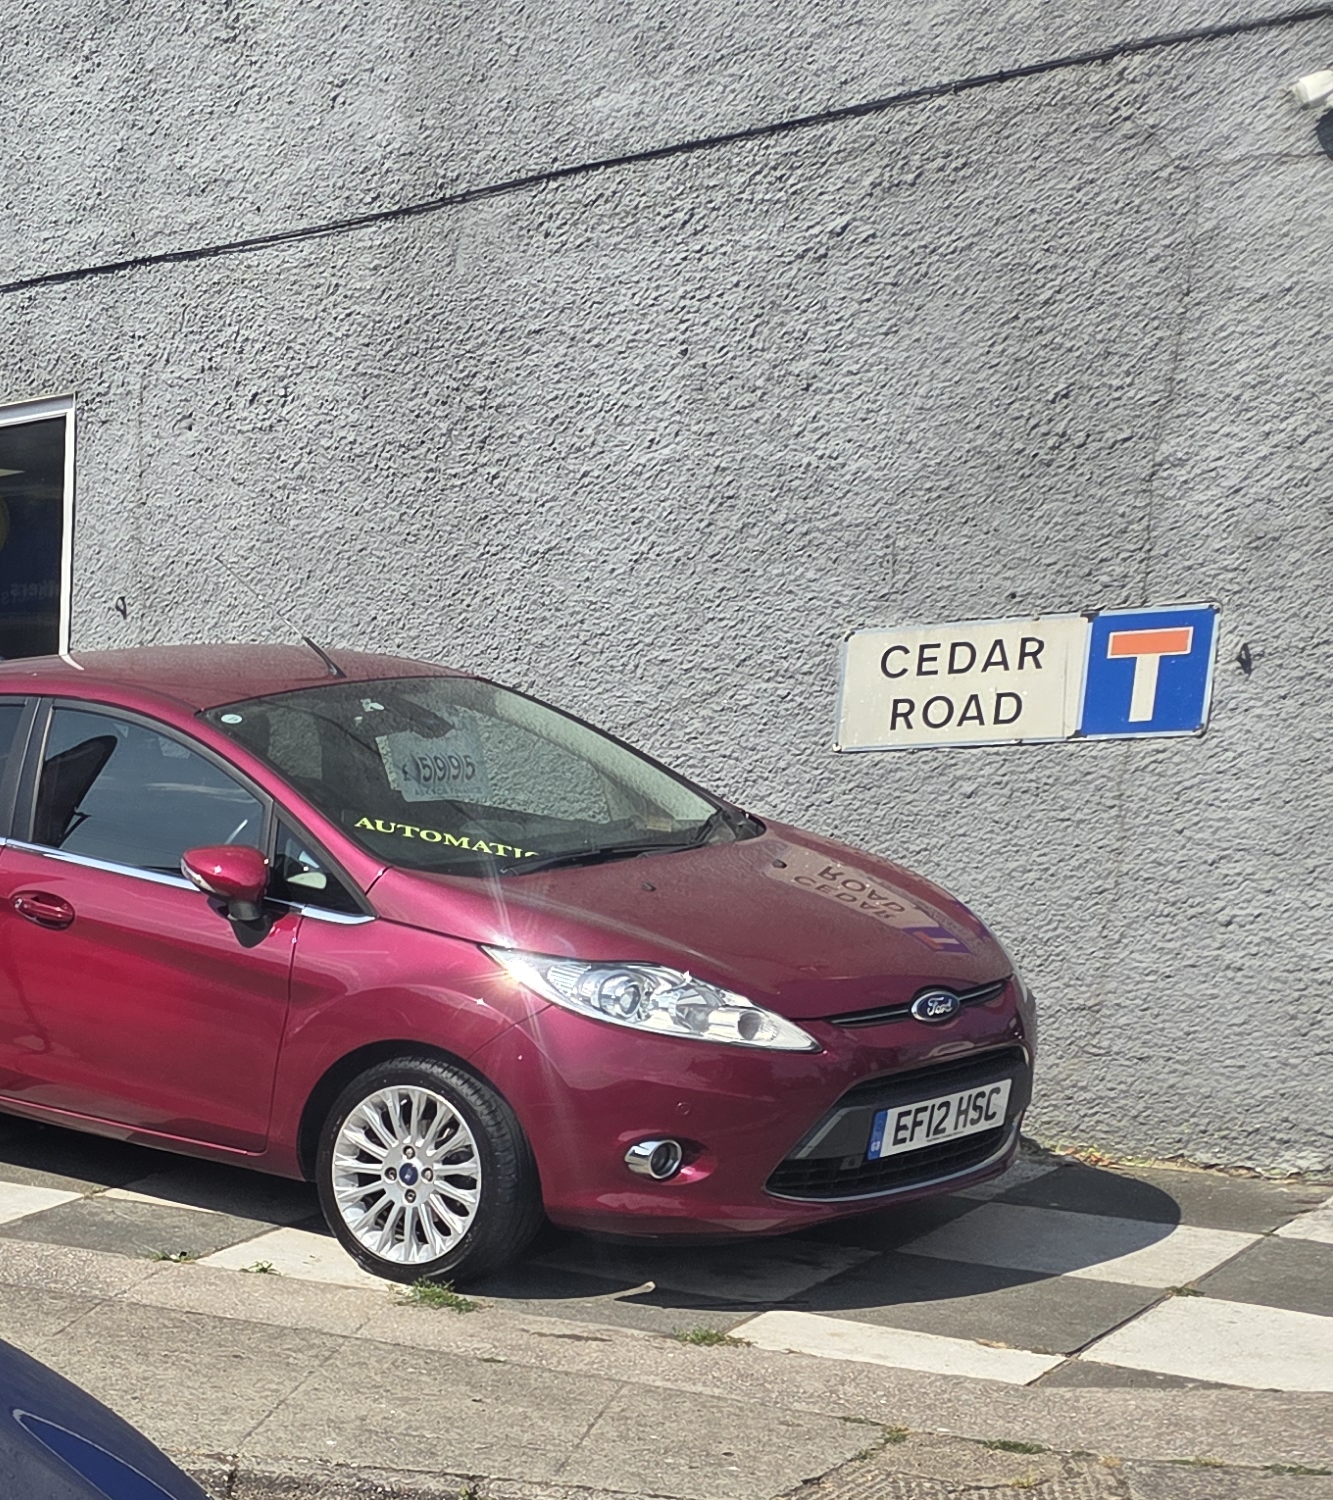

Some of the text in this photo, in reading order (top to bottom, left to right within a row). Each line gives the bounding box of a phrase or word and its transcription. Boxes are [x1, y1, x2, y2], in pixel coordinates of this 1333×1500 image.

[880, 636, 1045, 679] CEDAR
[890, 691, 1023, 731] ROAD
[419, 754, 476, 783] 5995
[926, 996, 952, 1016] Ford
[892, 1086, 1002, 1147] EF12 HSC
